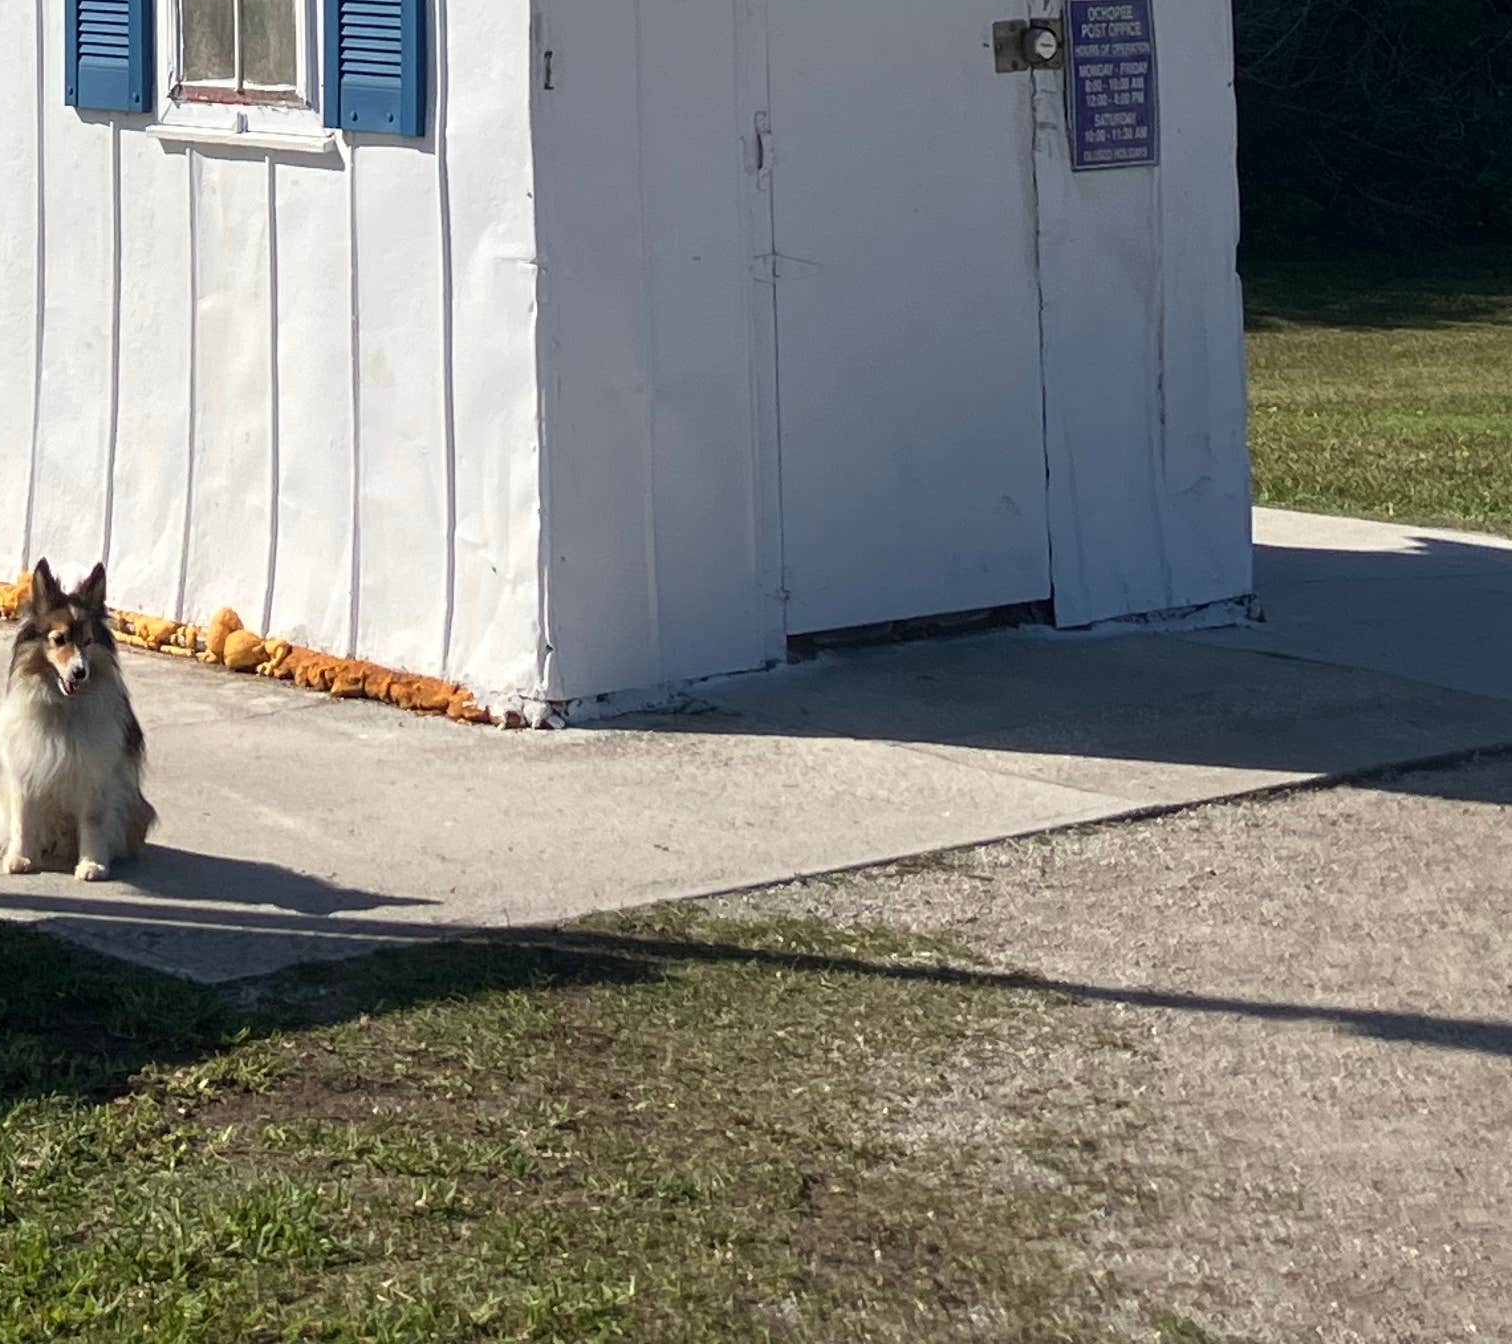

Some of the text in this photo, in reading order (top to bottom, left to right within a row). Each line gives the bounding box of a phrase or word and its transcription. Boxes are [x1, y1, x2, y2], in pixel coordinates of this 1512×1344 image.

[1080, 21, 1142, 39] POST OFFICE
[1079, 64, 1113, 78] MONDAY
[1119, 62, 1148, 76] FRIDAY
[1131, 90, 1145, 103] PM
[1094, 112, 1137, 127] SATURDAY
[1134, 126, 1148, 139] AM
